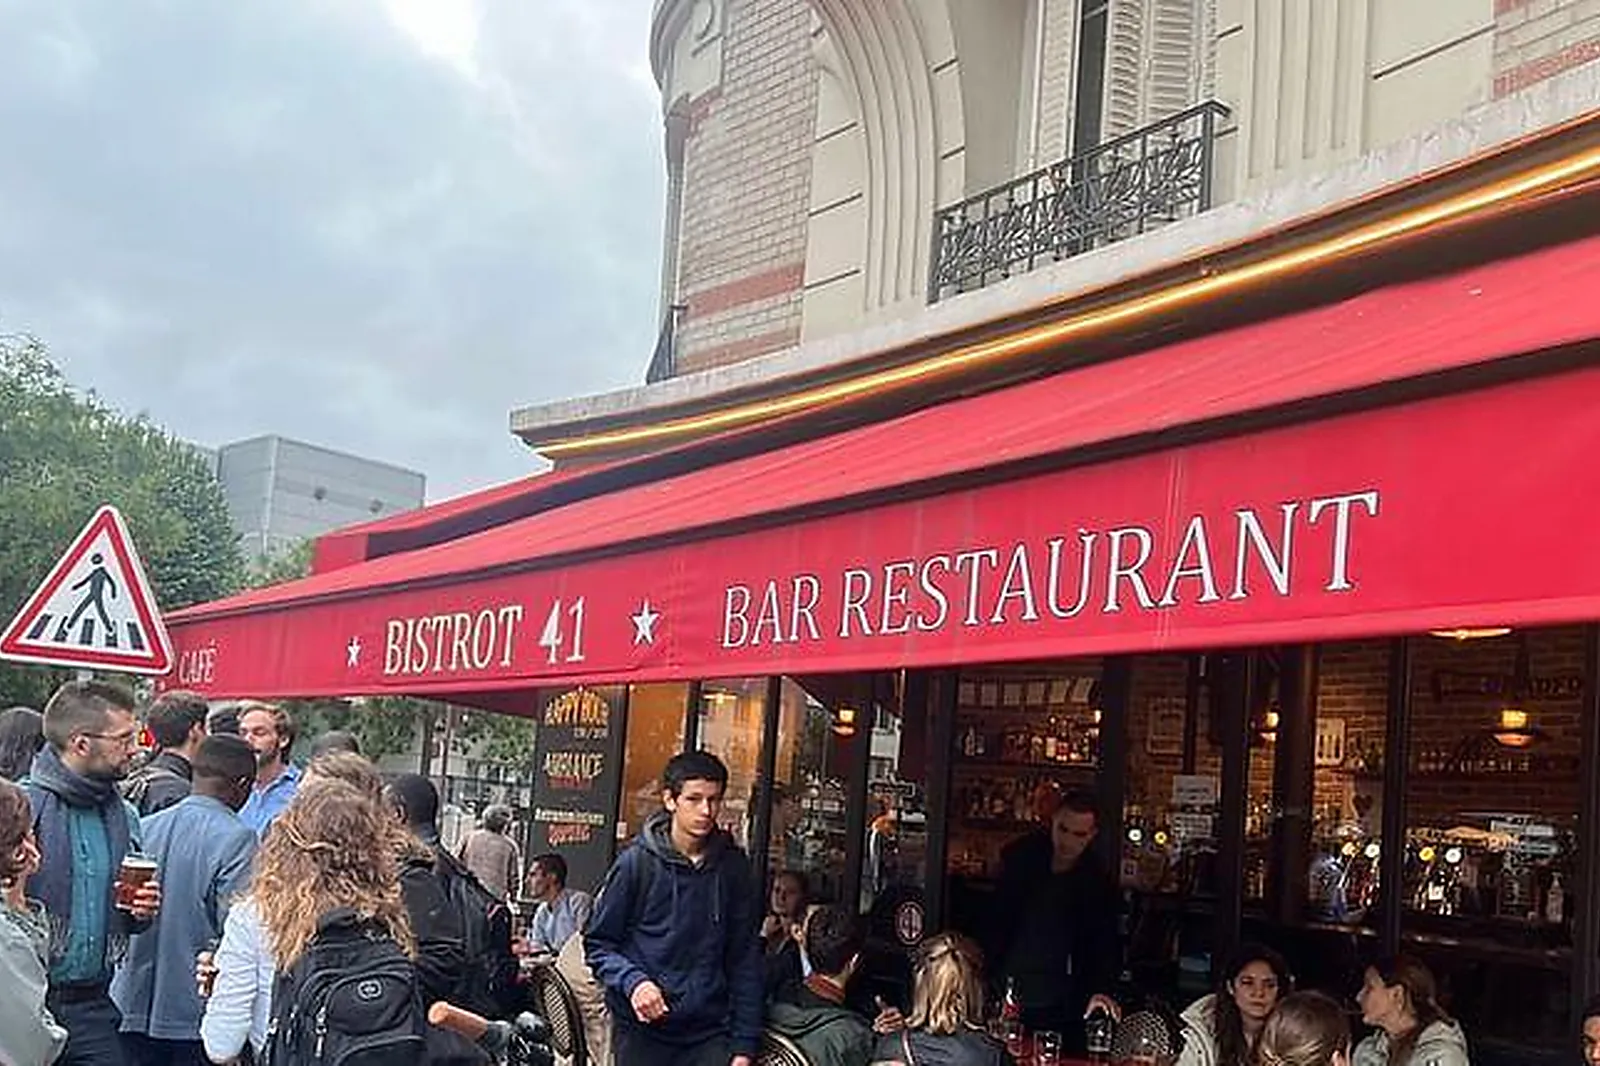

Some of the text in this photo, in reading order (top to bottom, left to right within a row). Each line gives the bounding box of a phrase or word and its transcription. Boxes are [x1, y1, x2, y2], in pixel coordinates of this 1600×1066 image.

[719, 491, 1379, 649] BAR RESTAURANT
[179, 638, 217, 684] CAFÉ
[383, 596, 586, 675] BISTROT 41
